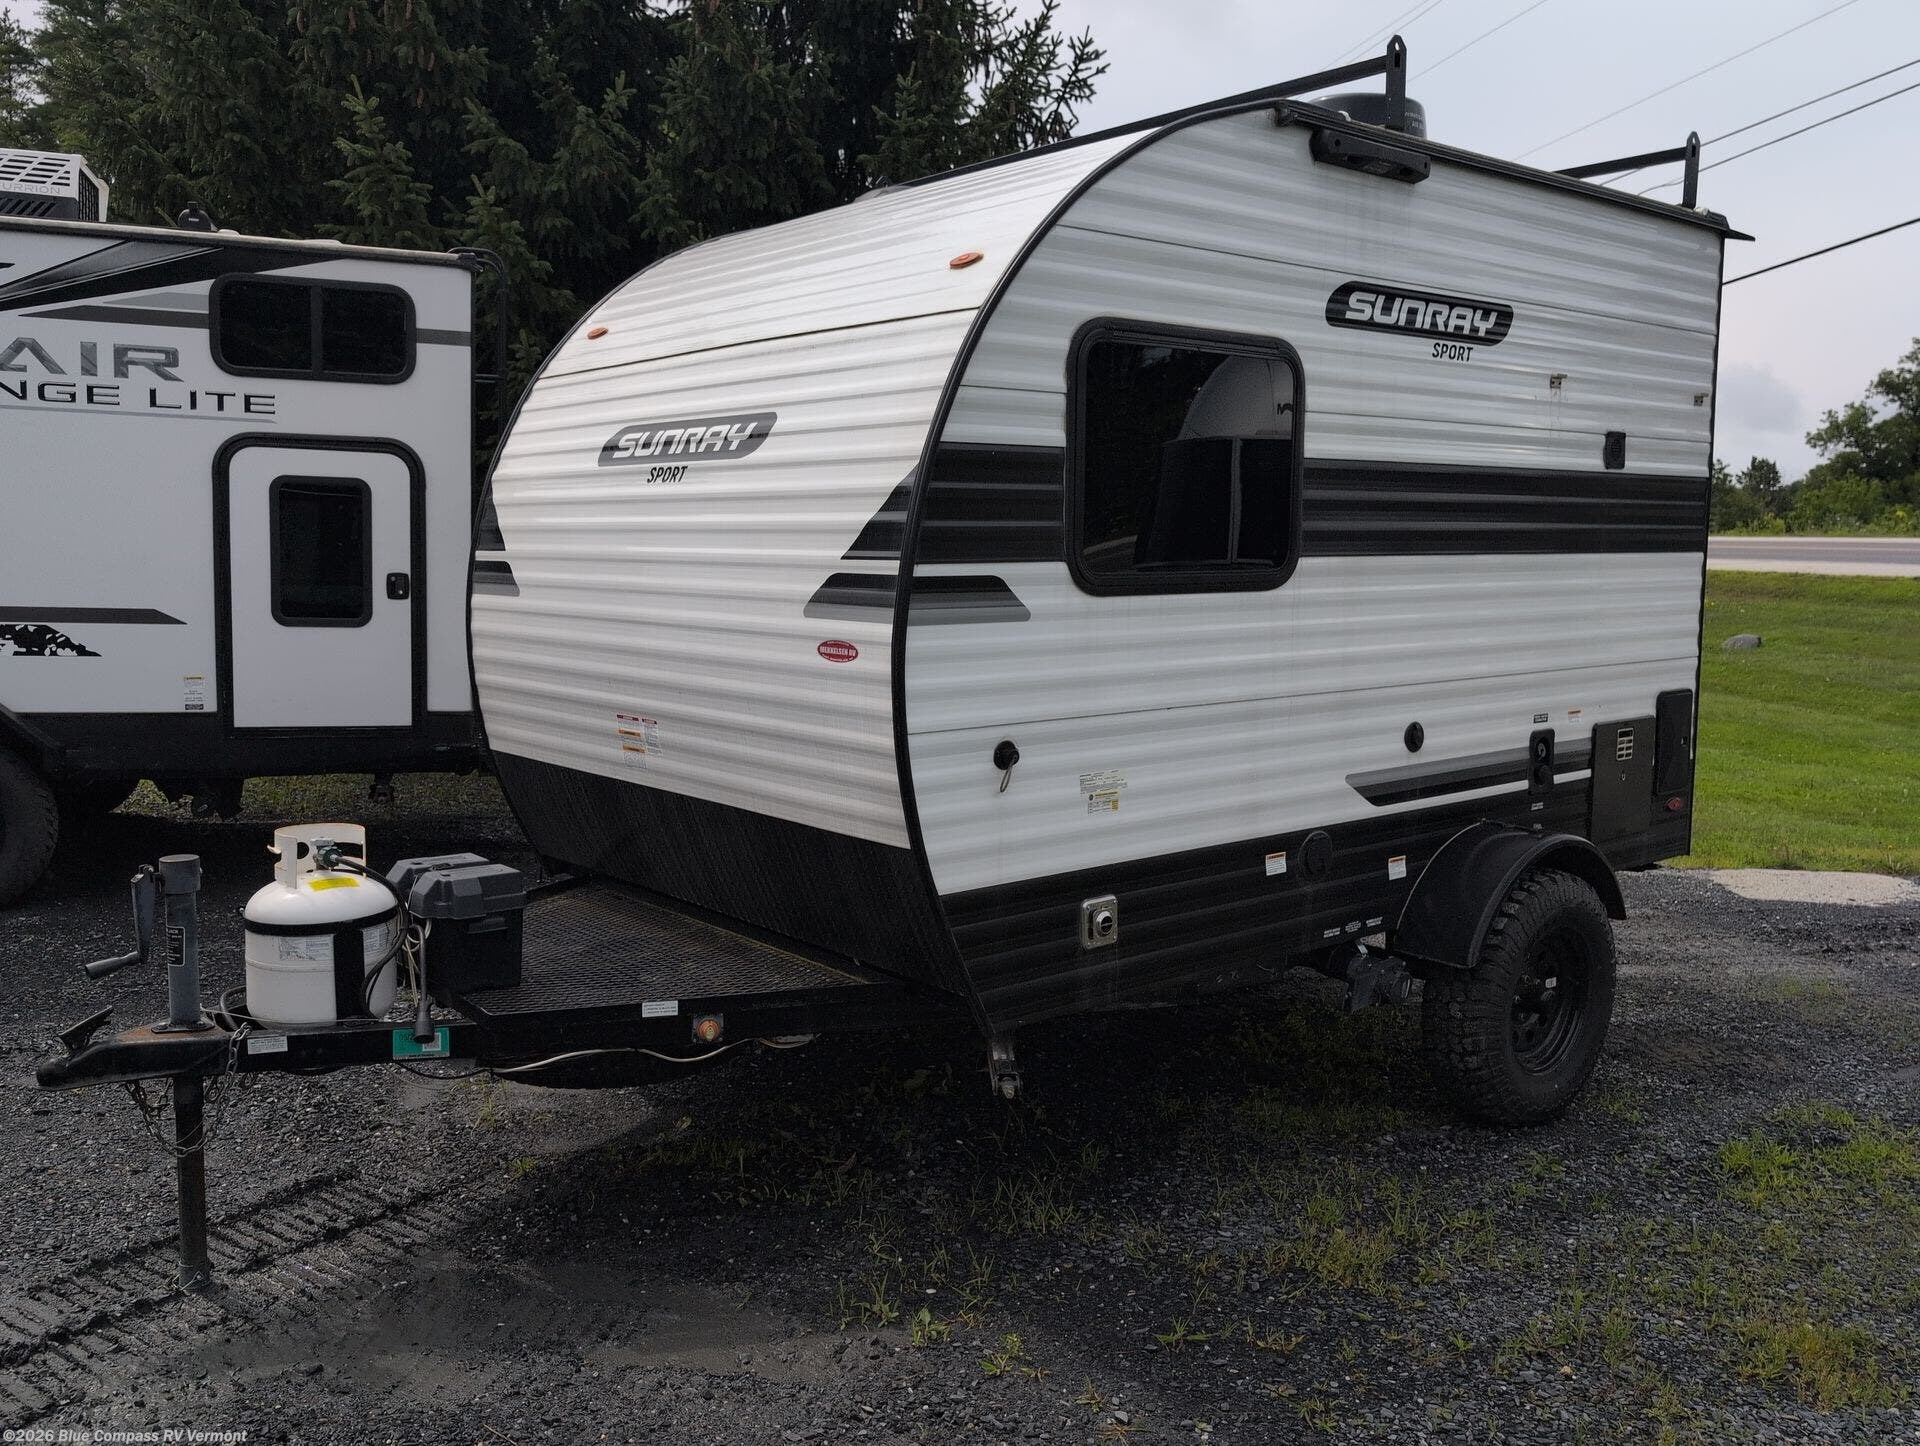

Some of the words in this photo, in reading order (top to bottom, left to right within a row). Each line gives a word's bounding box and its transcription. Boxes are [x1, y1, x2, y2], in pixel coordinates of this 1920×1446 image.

[1345, 291, 1498, 337] SUNRAY
[1432, 342, 1474, 362] SPORT
[149, 387, 276, 415] LITE
[612, 422, 758, 459] SUNRAY
[647, 466, 688, 483] SPORT
